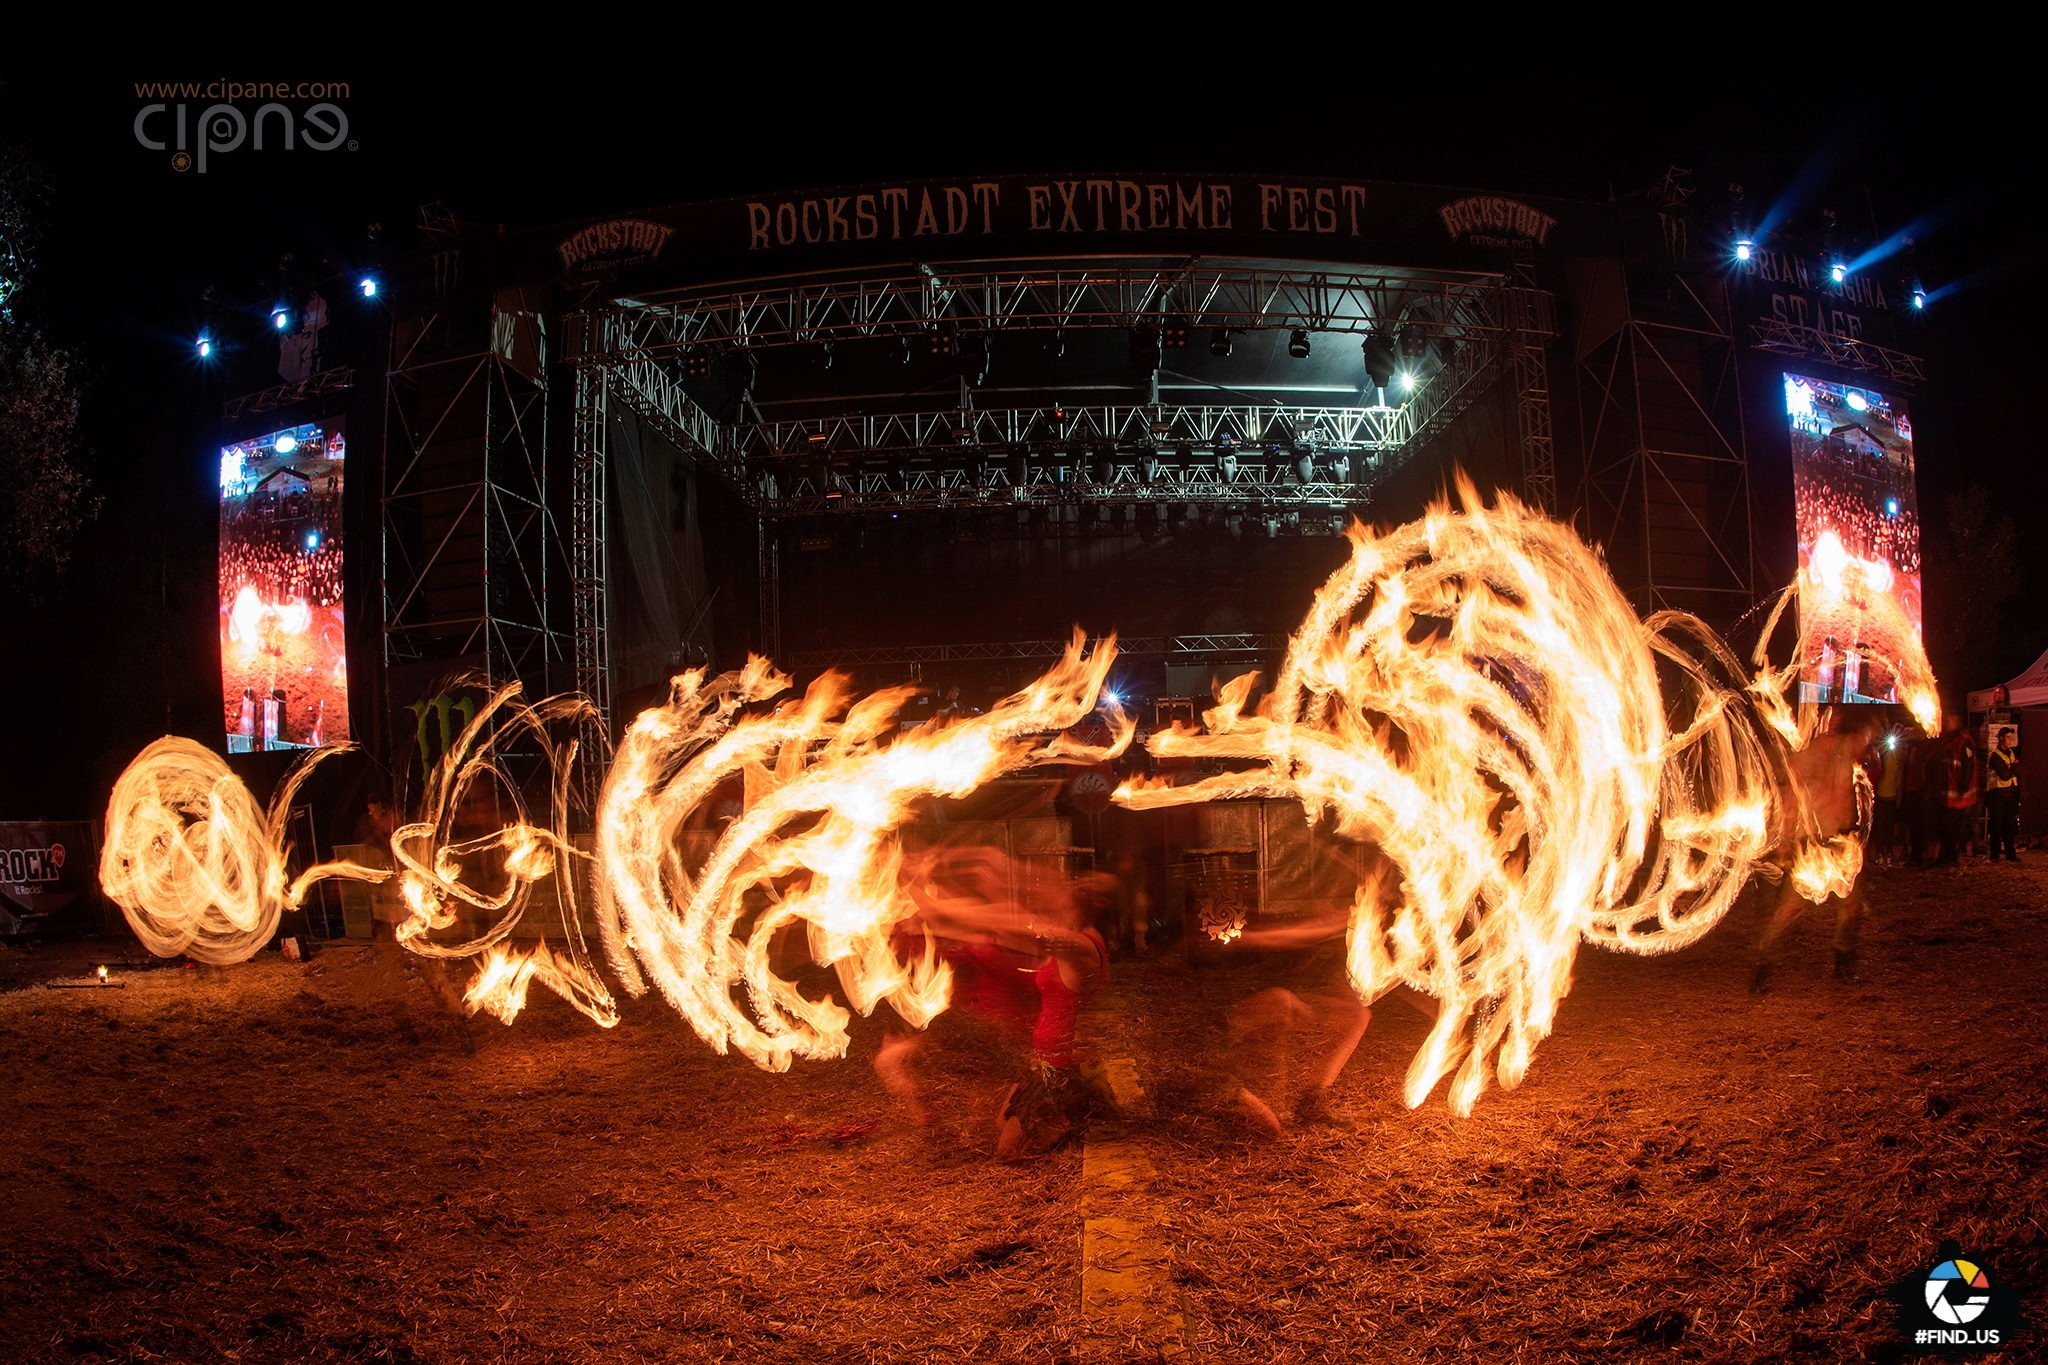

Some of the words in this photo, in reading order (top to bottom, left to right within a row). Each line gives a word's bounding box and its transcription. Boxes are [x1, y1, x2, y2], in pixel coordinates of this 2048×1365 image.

[745, 182, 1000, 250] ROCKSTADT
[1024, 180, 1233, 233] EXTREME
[1257, 183, 1367, 237] FEST
[1439, 197, 1560, 248] ROCKSTADT
[557, 218, 679, 271] ROCKSTADT
